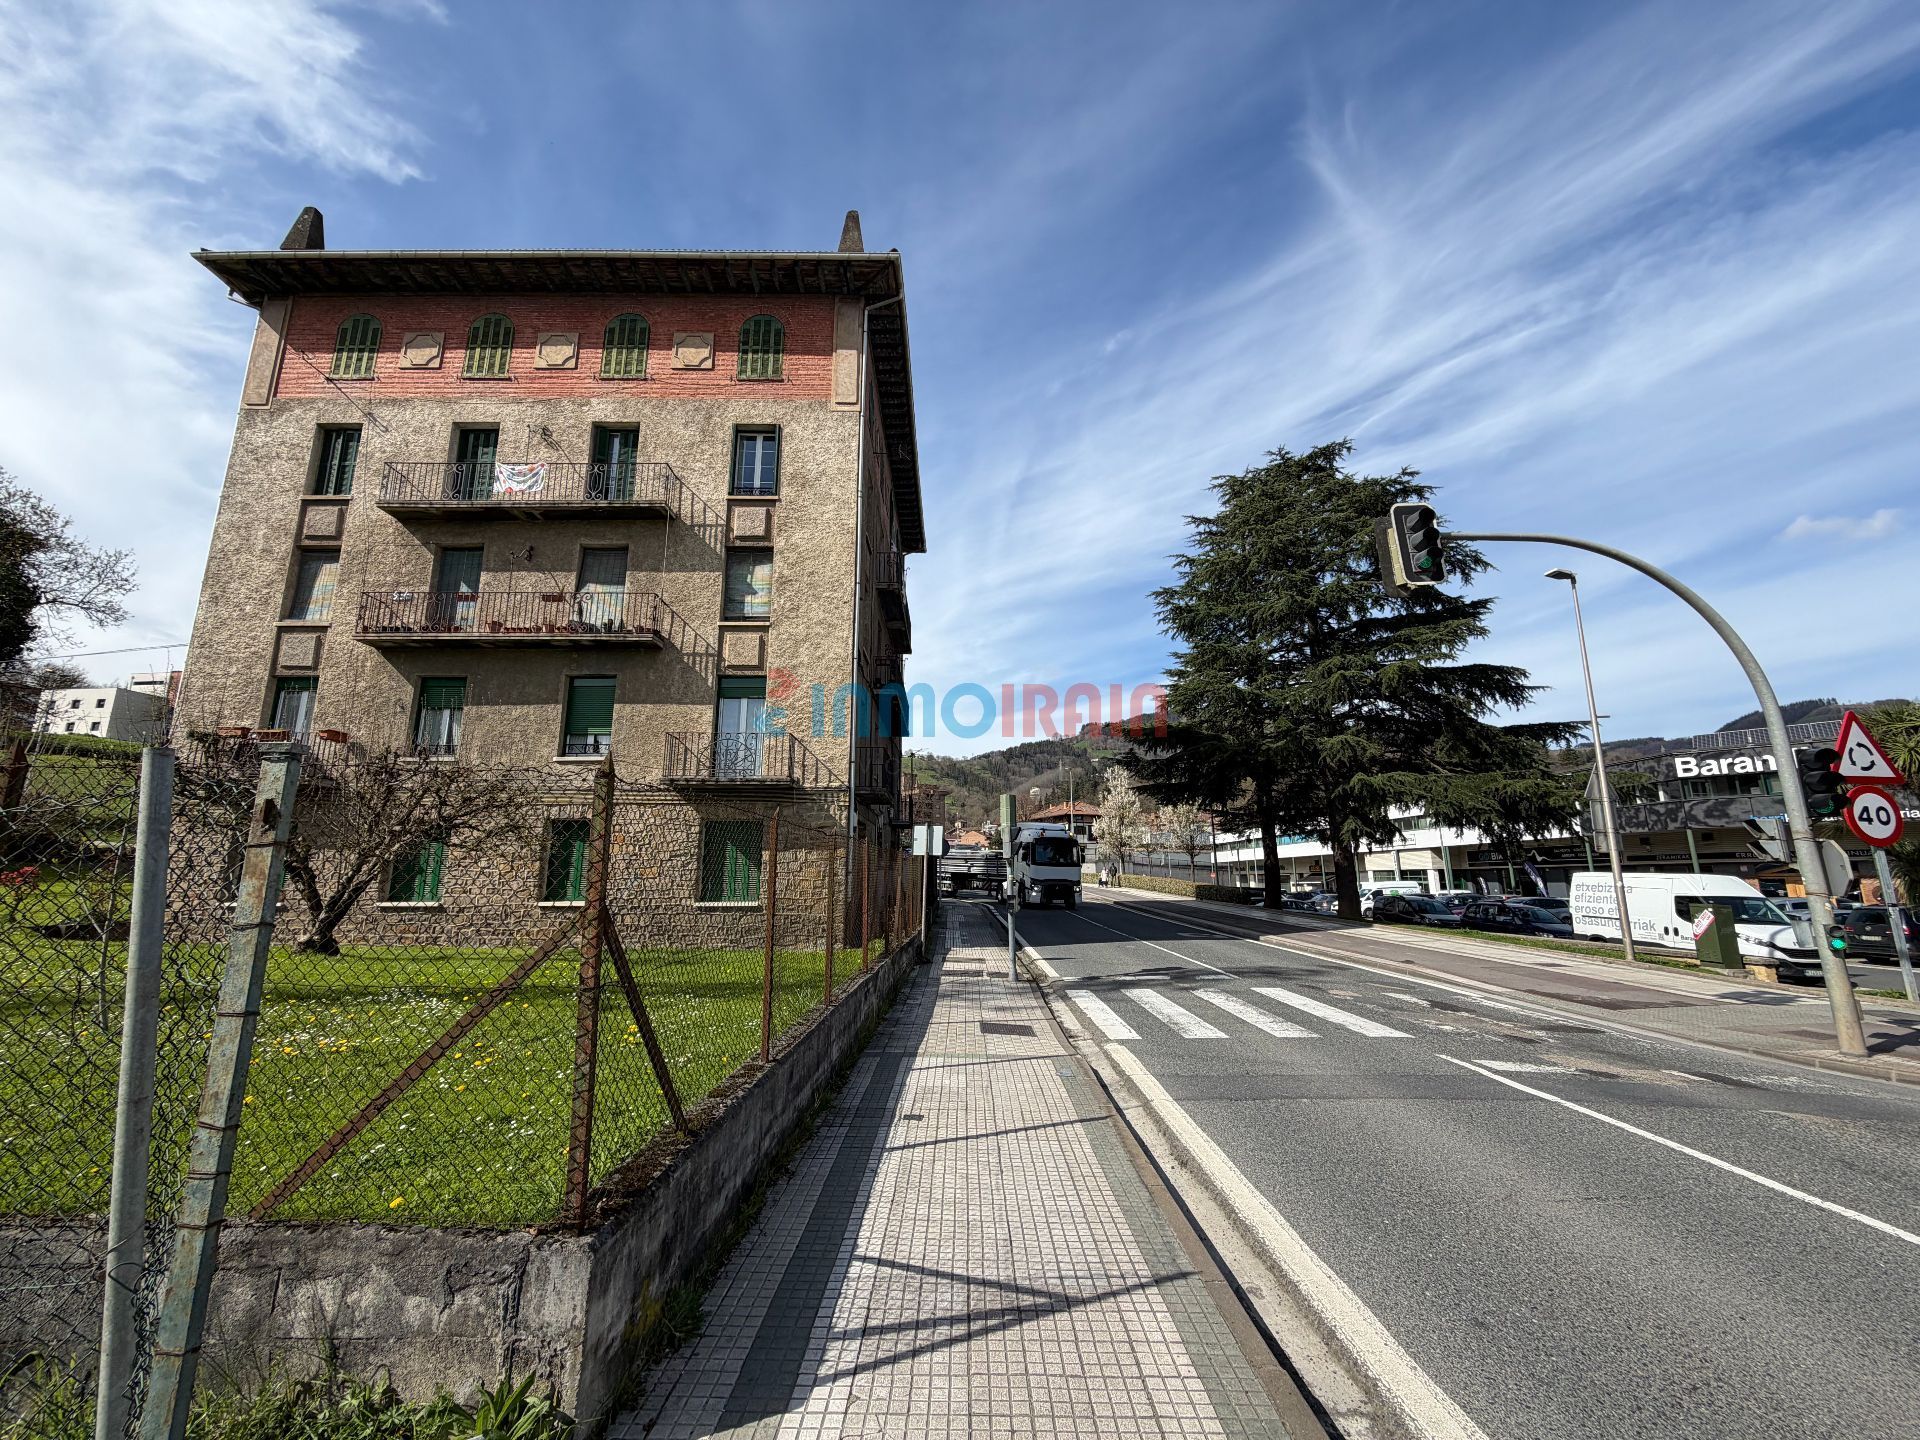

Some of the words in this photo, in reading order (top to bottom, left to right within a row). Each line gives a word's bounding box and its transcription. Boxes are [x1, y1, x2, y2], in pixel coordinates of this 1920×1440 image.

[1858, 806, 1891, 826] 40
[1575, 882, 1632, 894] etxebiza
[1574, 905, 1604, 915] eroso
